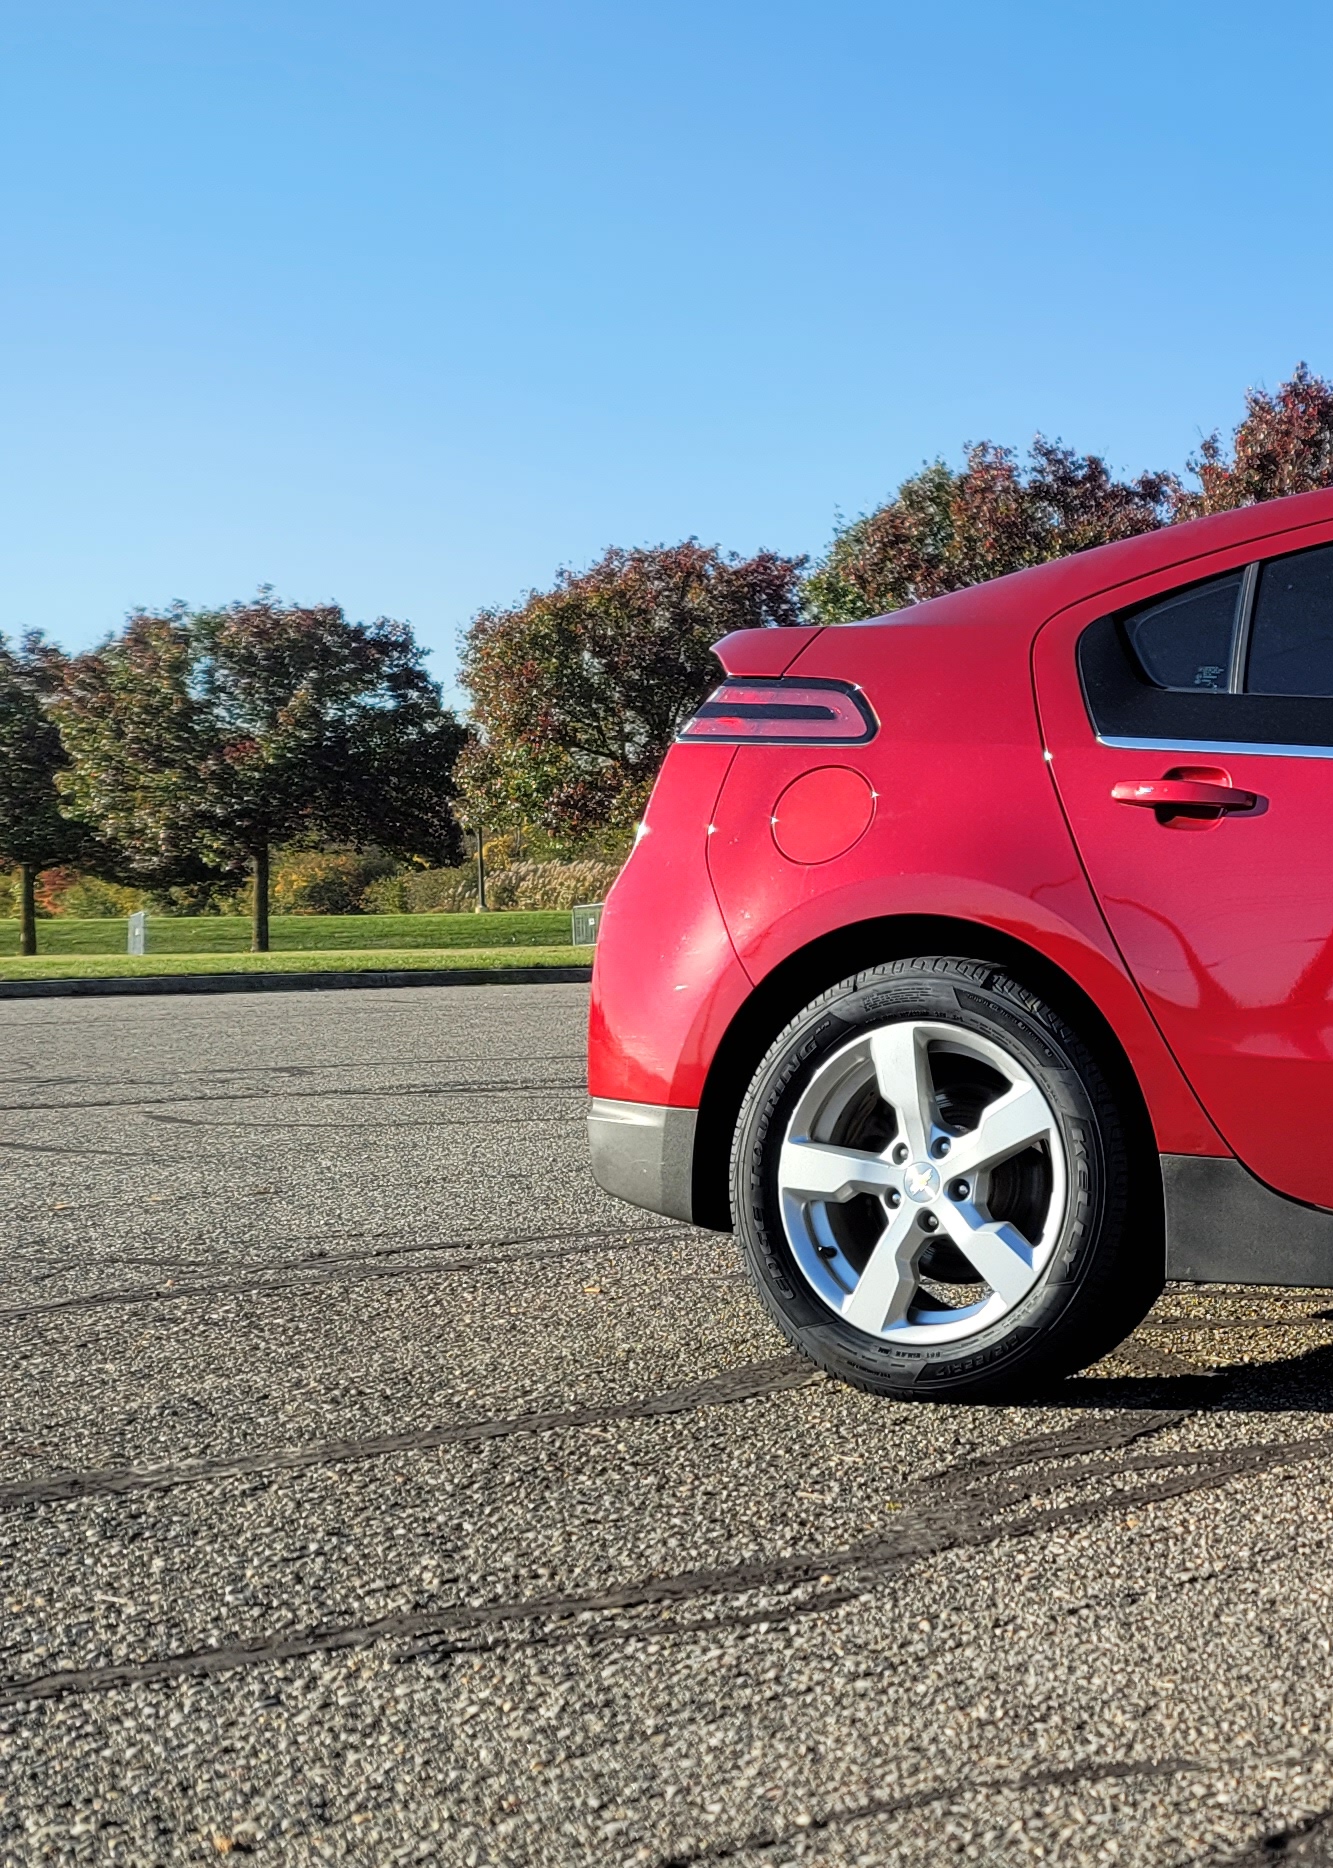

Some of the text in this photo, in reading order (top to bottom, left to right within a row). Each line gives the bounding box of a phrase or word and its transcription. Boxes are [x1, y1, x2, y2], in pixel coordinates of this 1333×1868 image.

[750, 1034, 818, 1190] TOURING
[752, 1205, 796, 1299] EDGE
[1062, 1127, 1092, 1278] KELLY
